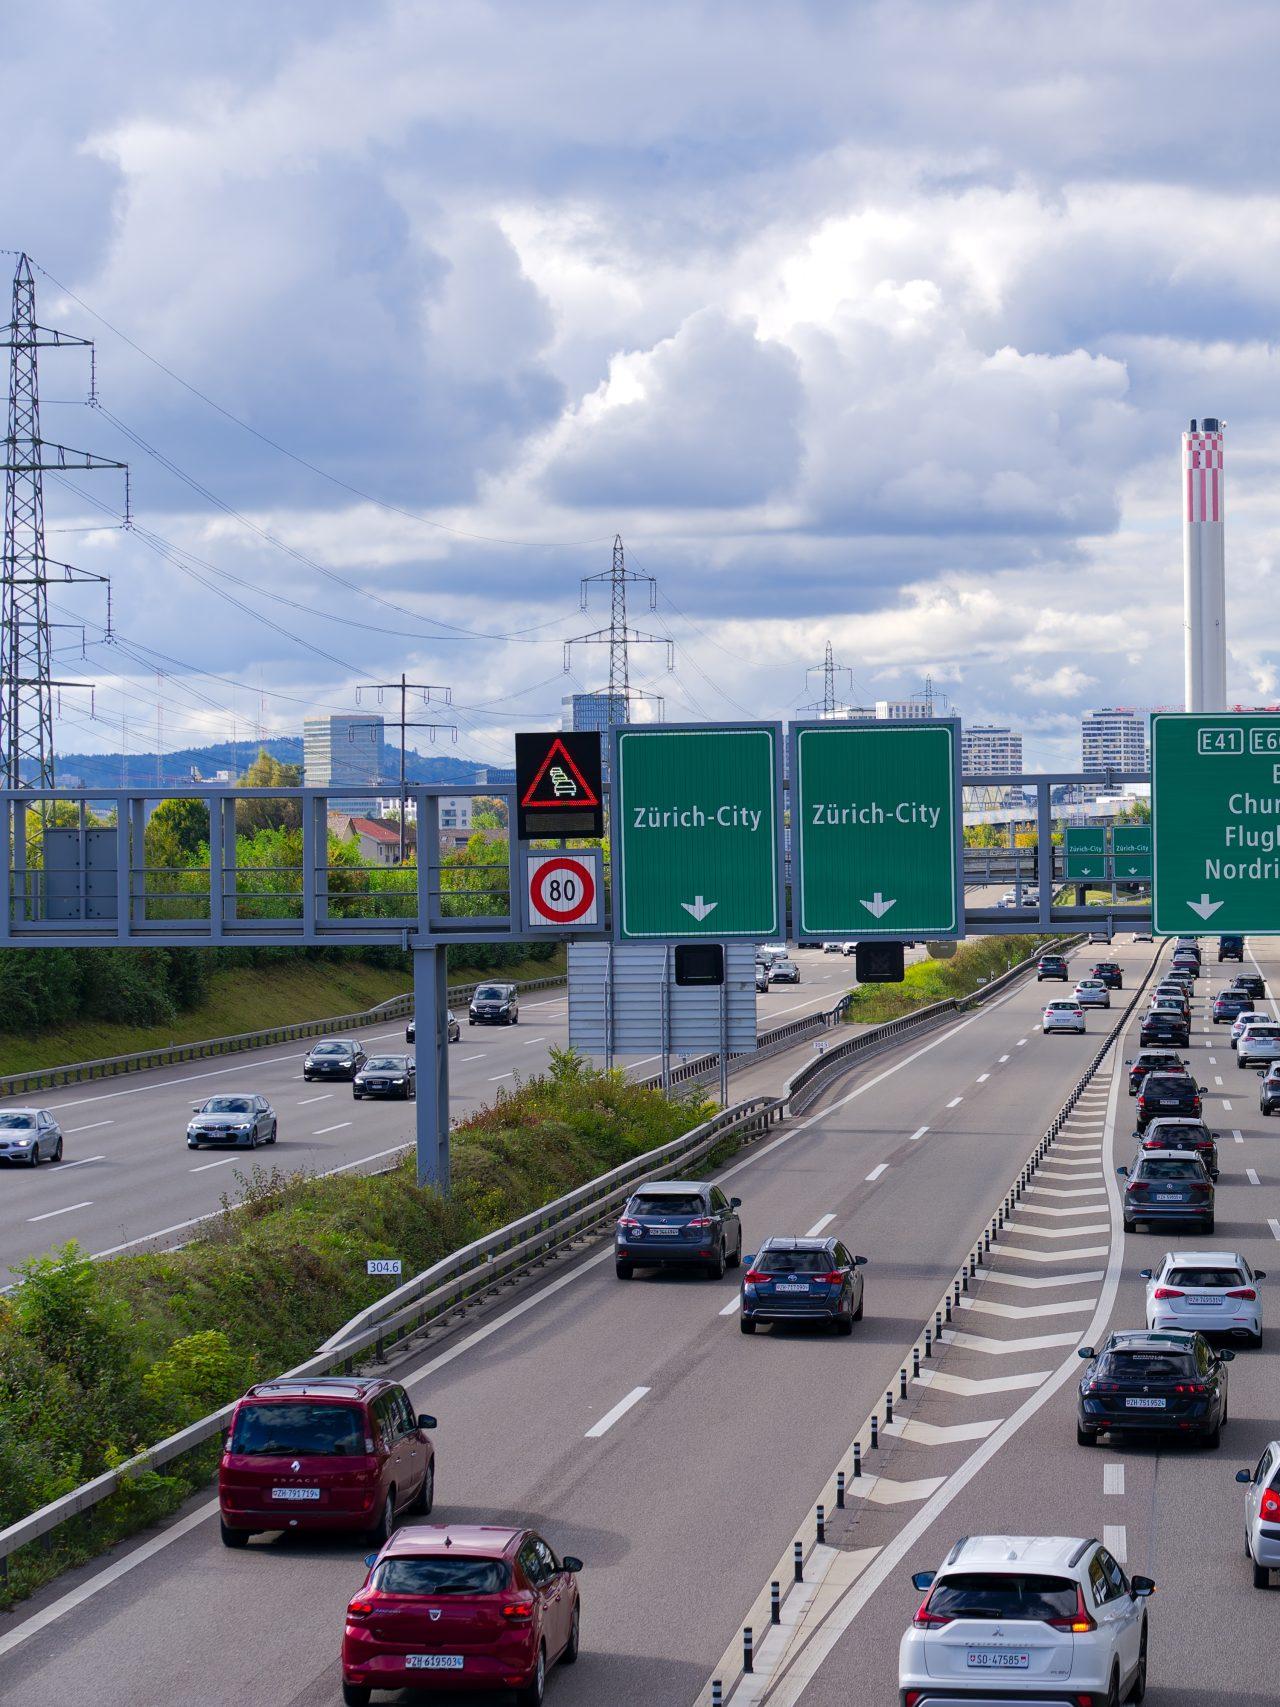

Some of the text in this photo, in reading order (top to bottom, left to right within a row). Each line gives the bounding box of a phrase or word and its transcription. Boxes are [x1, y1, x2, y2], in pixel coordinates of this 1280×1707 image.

[1202, 733, 1236, 750] E41
[633, 805, 762, 832] Zürich-City
[812, 802, 941, 829] Zürich-City
[1069, 845, 1103, 853] Zürich-City
[1116, 844, 1149, 852] Zürich-City
[549, 879, 576, 902] 80
[370, 1261, 399, 1273] 304.6
